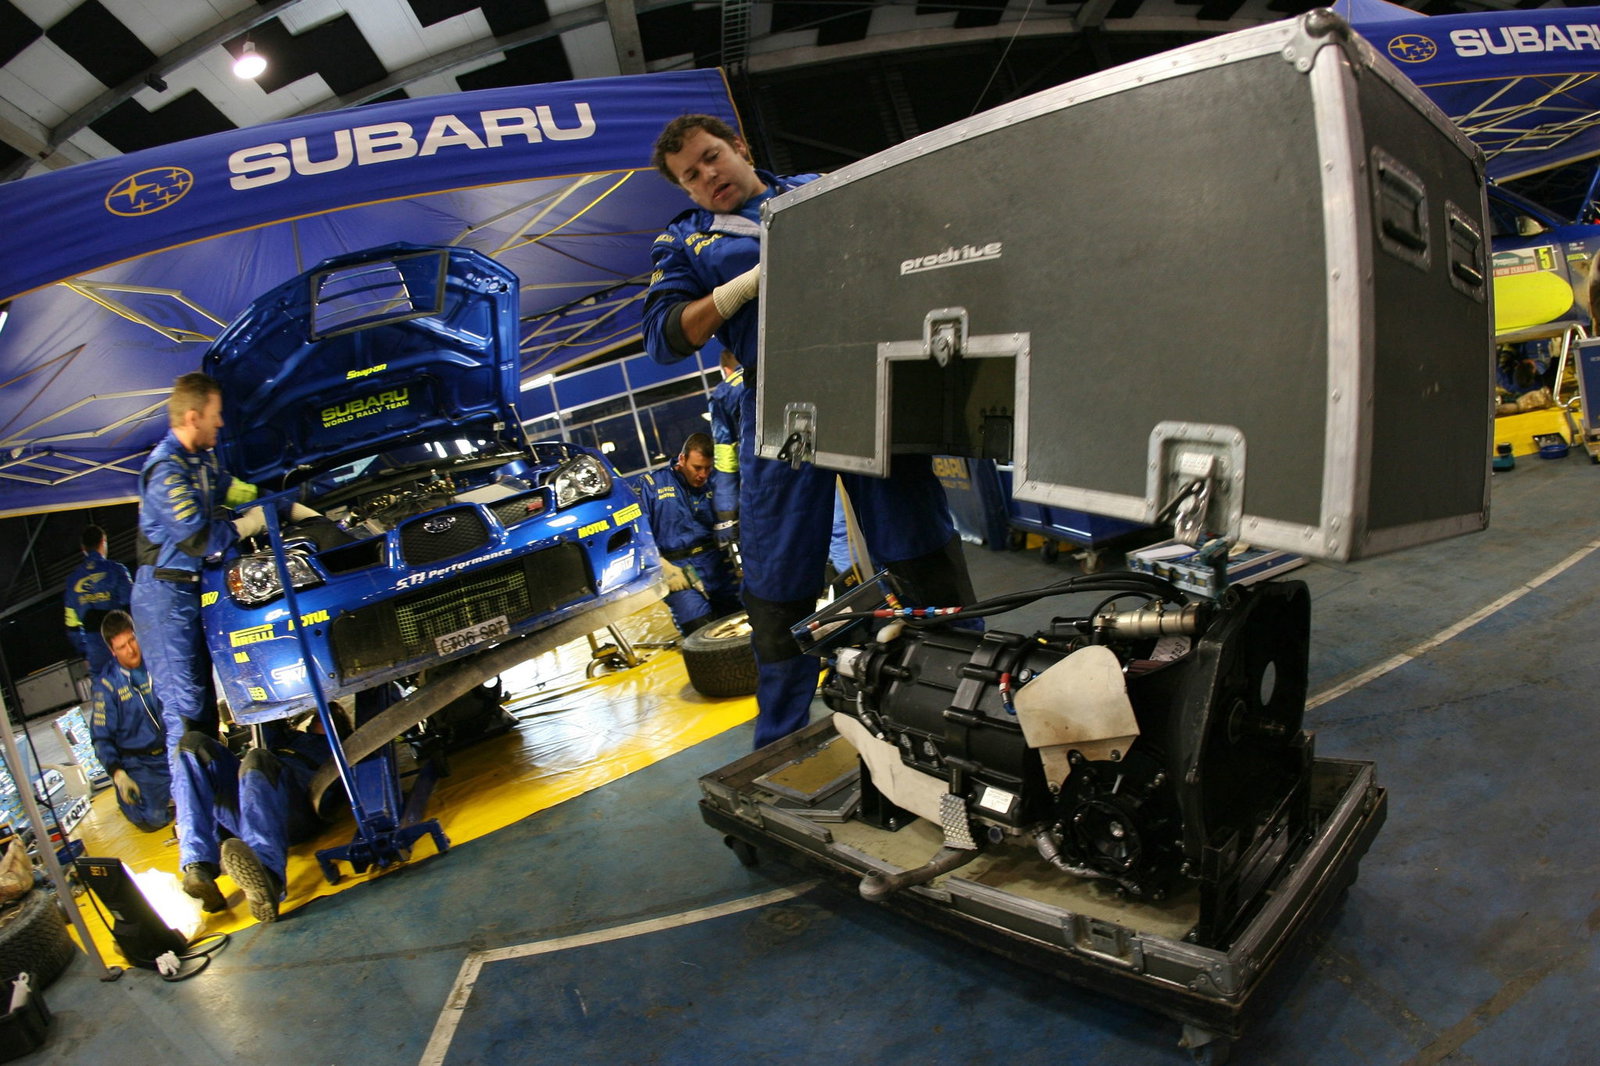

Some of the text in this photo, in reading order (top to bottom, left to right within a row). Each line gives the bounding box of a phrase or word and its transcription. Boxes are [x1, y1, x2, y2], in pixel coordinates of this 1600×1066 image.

[1450, 24, 1600, 57] SUBAR
[228, 102, 597, 191] SUBARU
[900, 241, 1003, 276] prodrive
[1538, 248, 1551, 269] 5
[321, 387, 409, 422] SUBARU
[323, 400, 410, 429] WORLD RALLY TEAM
[577, 519, 610, 539] MOTUL
[428, 548, 513, 579] Performance
[229, 623, 275, 648] PIRELLI
